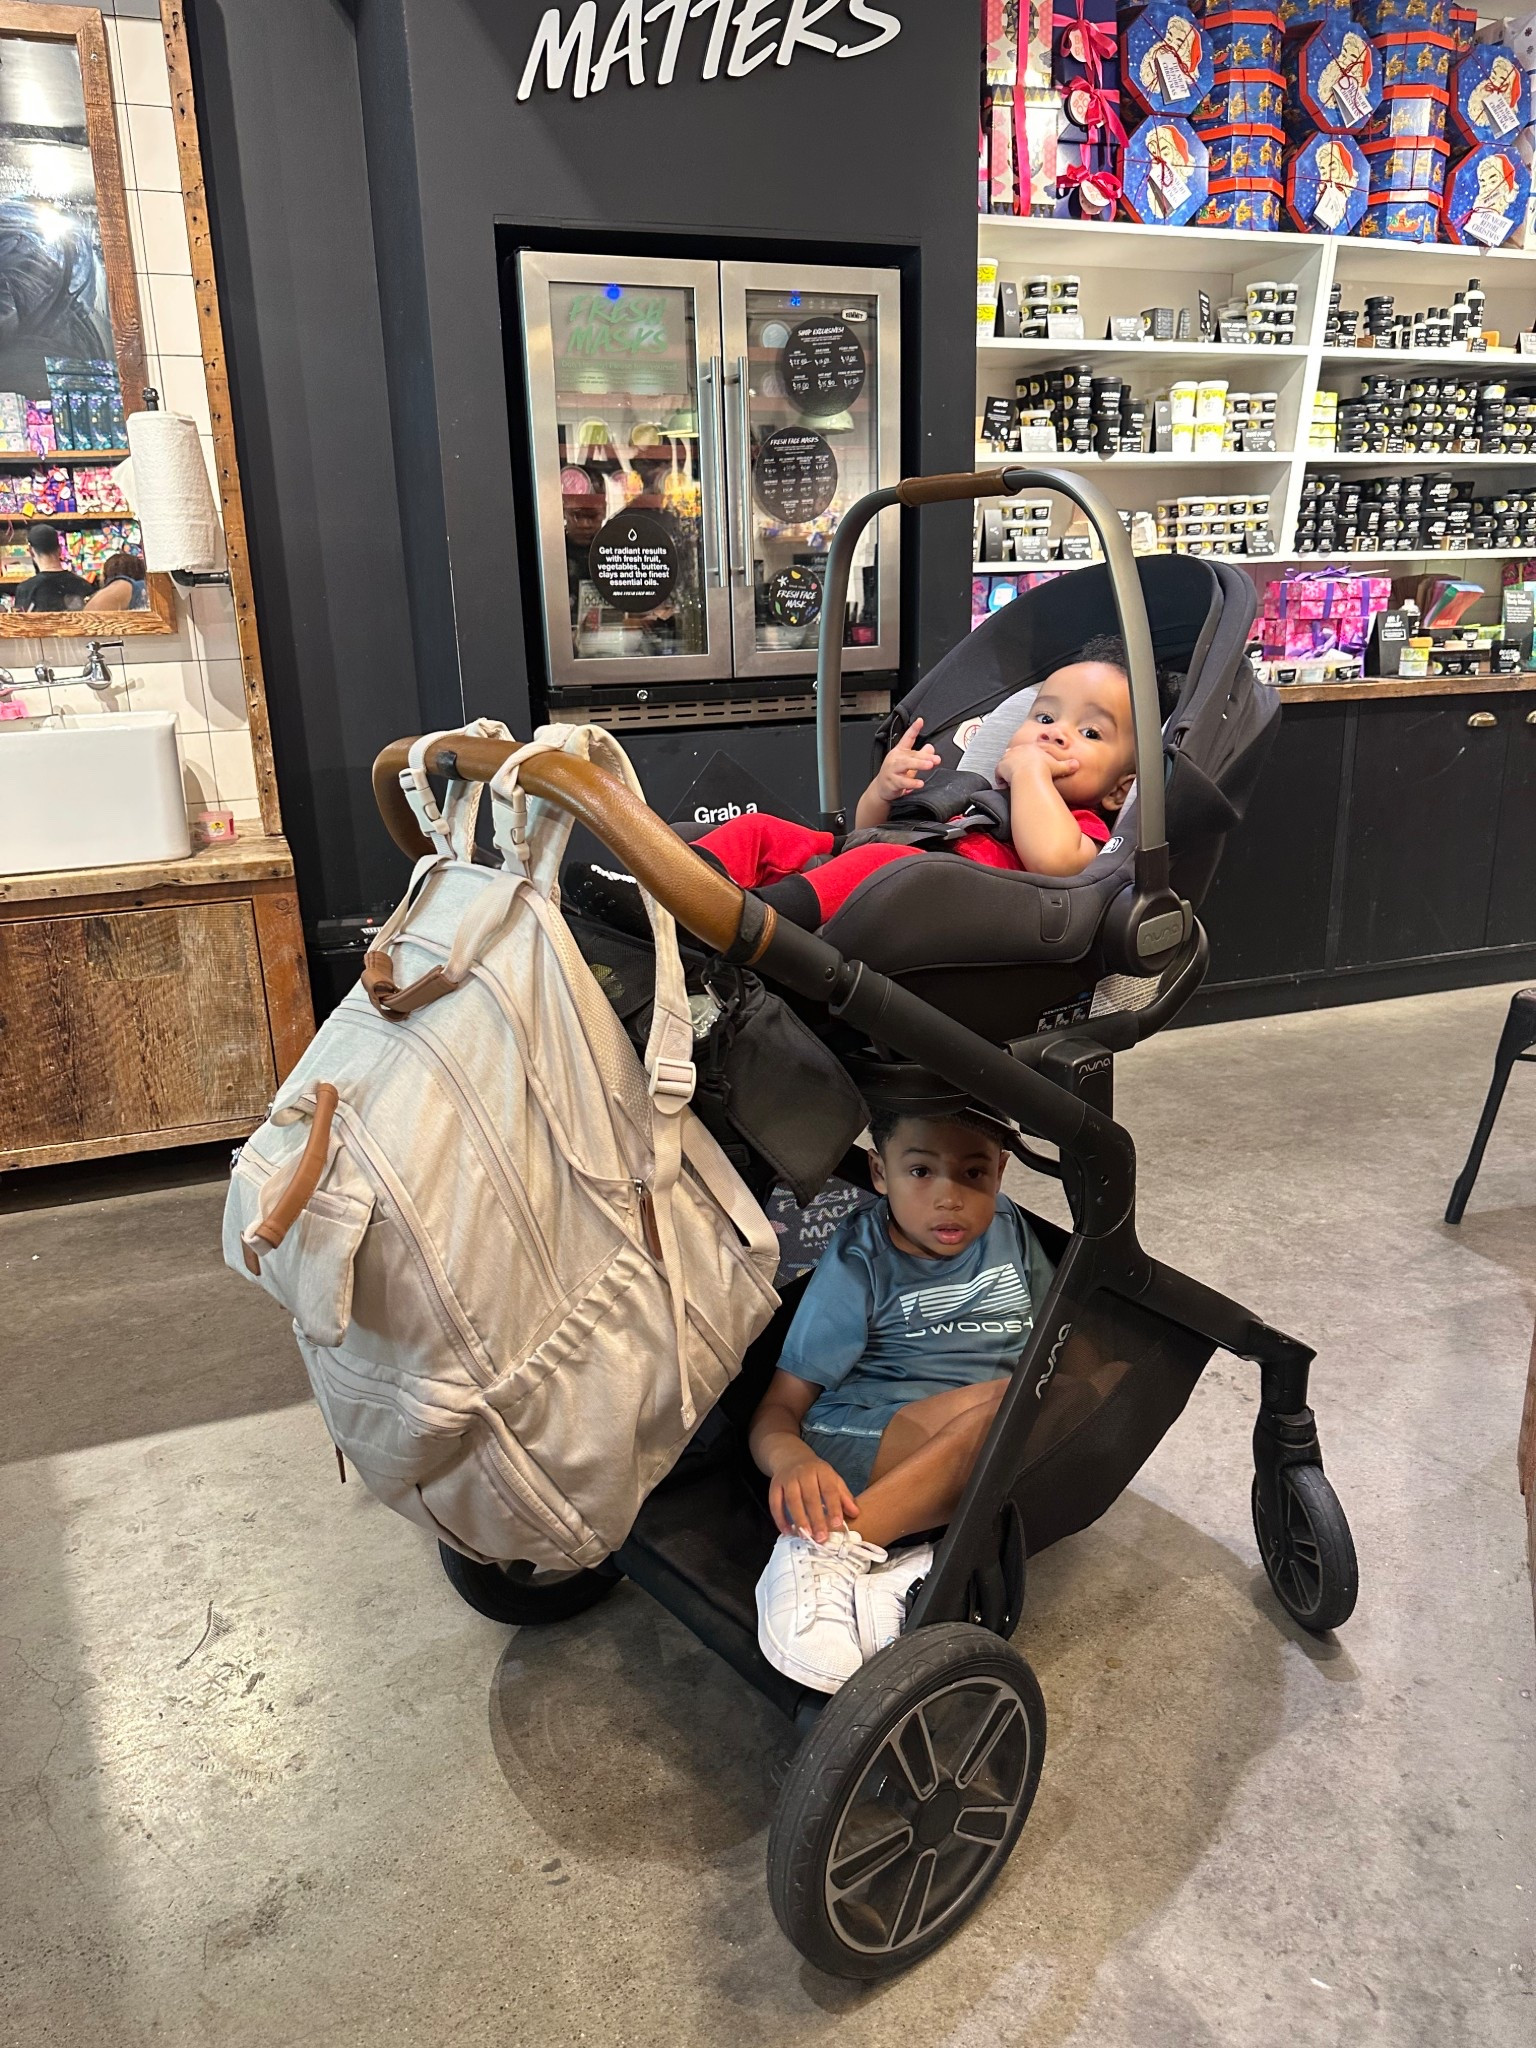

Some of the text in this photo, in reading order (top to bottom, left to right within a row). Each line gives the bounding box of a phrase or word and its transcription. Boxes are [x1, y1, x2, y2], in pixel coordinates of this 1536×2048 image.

[516, 0, 902, 101] MATTERS
[569, 293, 667, 325] FRESH
[567, 323, 668, 355] MASKS
[787, 437, 801, 445] FACE
[800, 436, 820, 445] MASKS
[598, 546, 667, 555] Get radiant results
[606, 555, 661, 564] with fresh fruit,
[597, 563, 670, 572] vegetables, butters,
[598, 571, 618, 579] clays
[776, 589, 817, 600] FRESH FACE
[785, 599, 807, 608] MASK
[694, 802, 758, 824] Grab a
[1078, 1057, 1111, 1074] nuna
